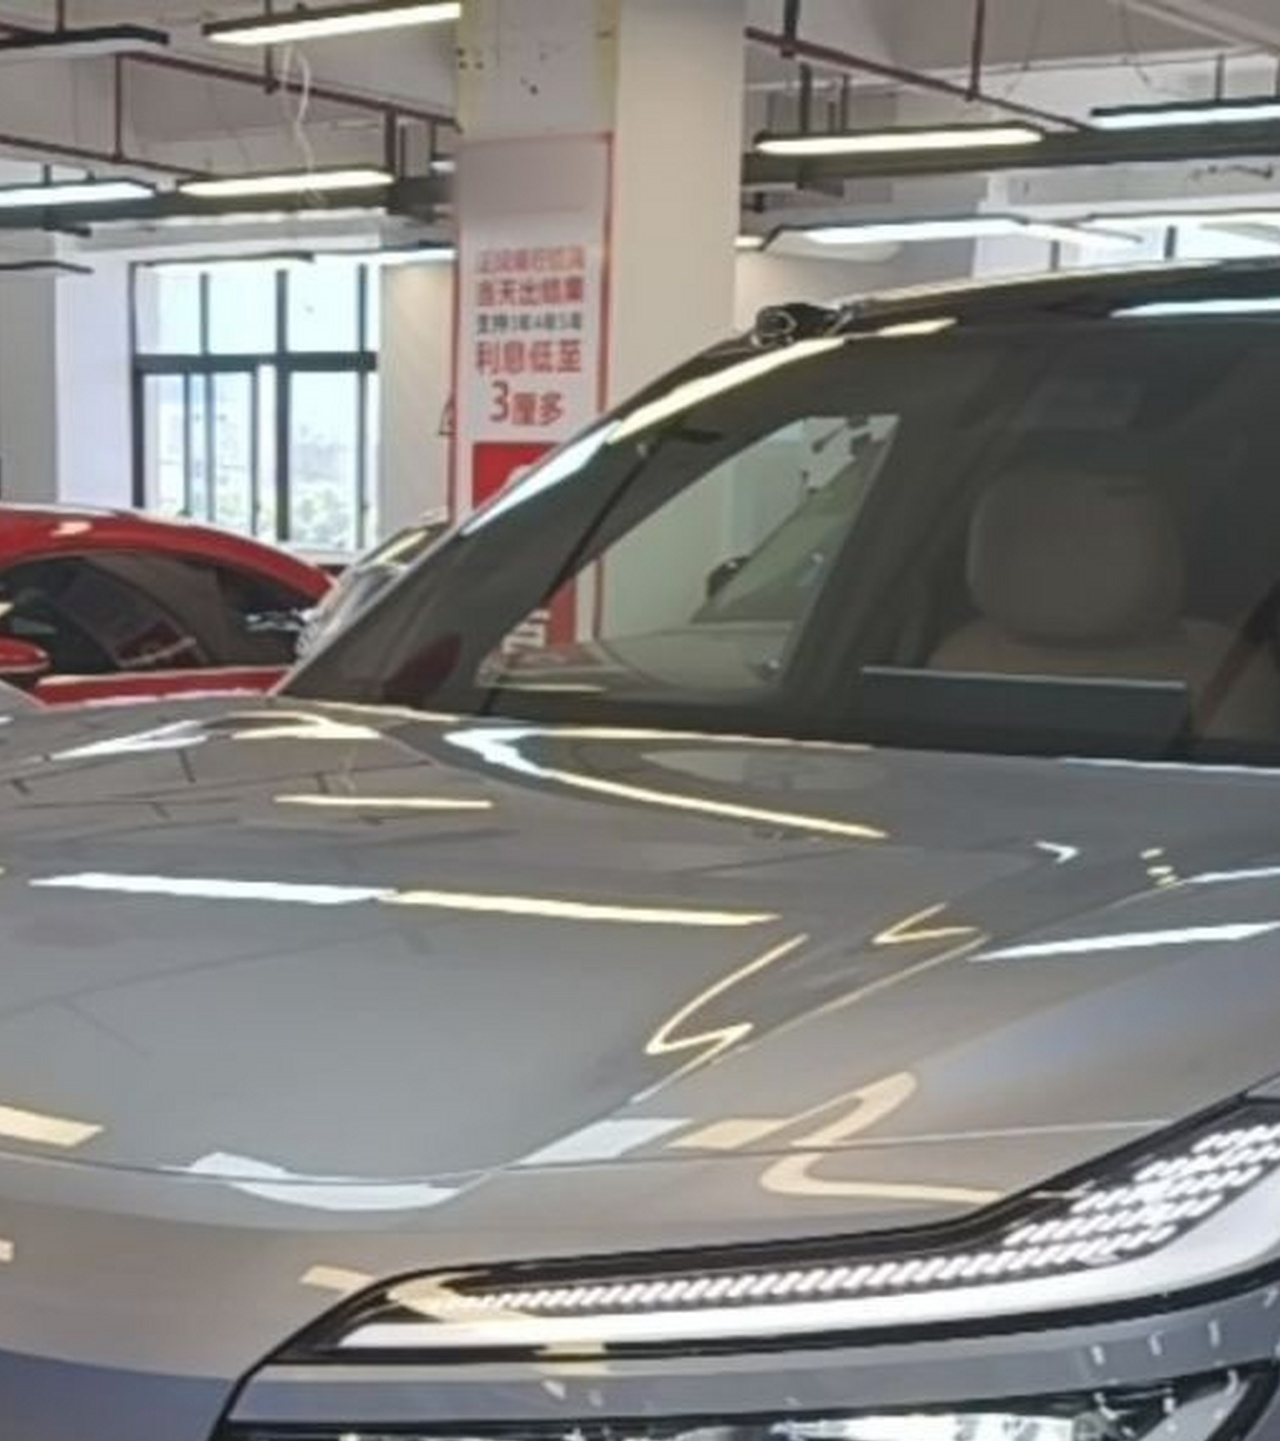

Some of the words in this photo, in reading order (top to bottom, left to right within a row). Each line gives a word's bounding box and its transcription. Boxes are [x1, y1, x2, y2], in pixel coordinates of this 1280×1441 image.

[476, 339, 581, 375] 利息低至
[489, 380, 564, 427] 3厘多
